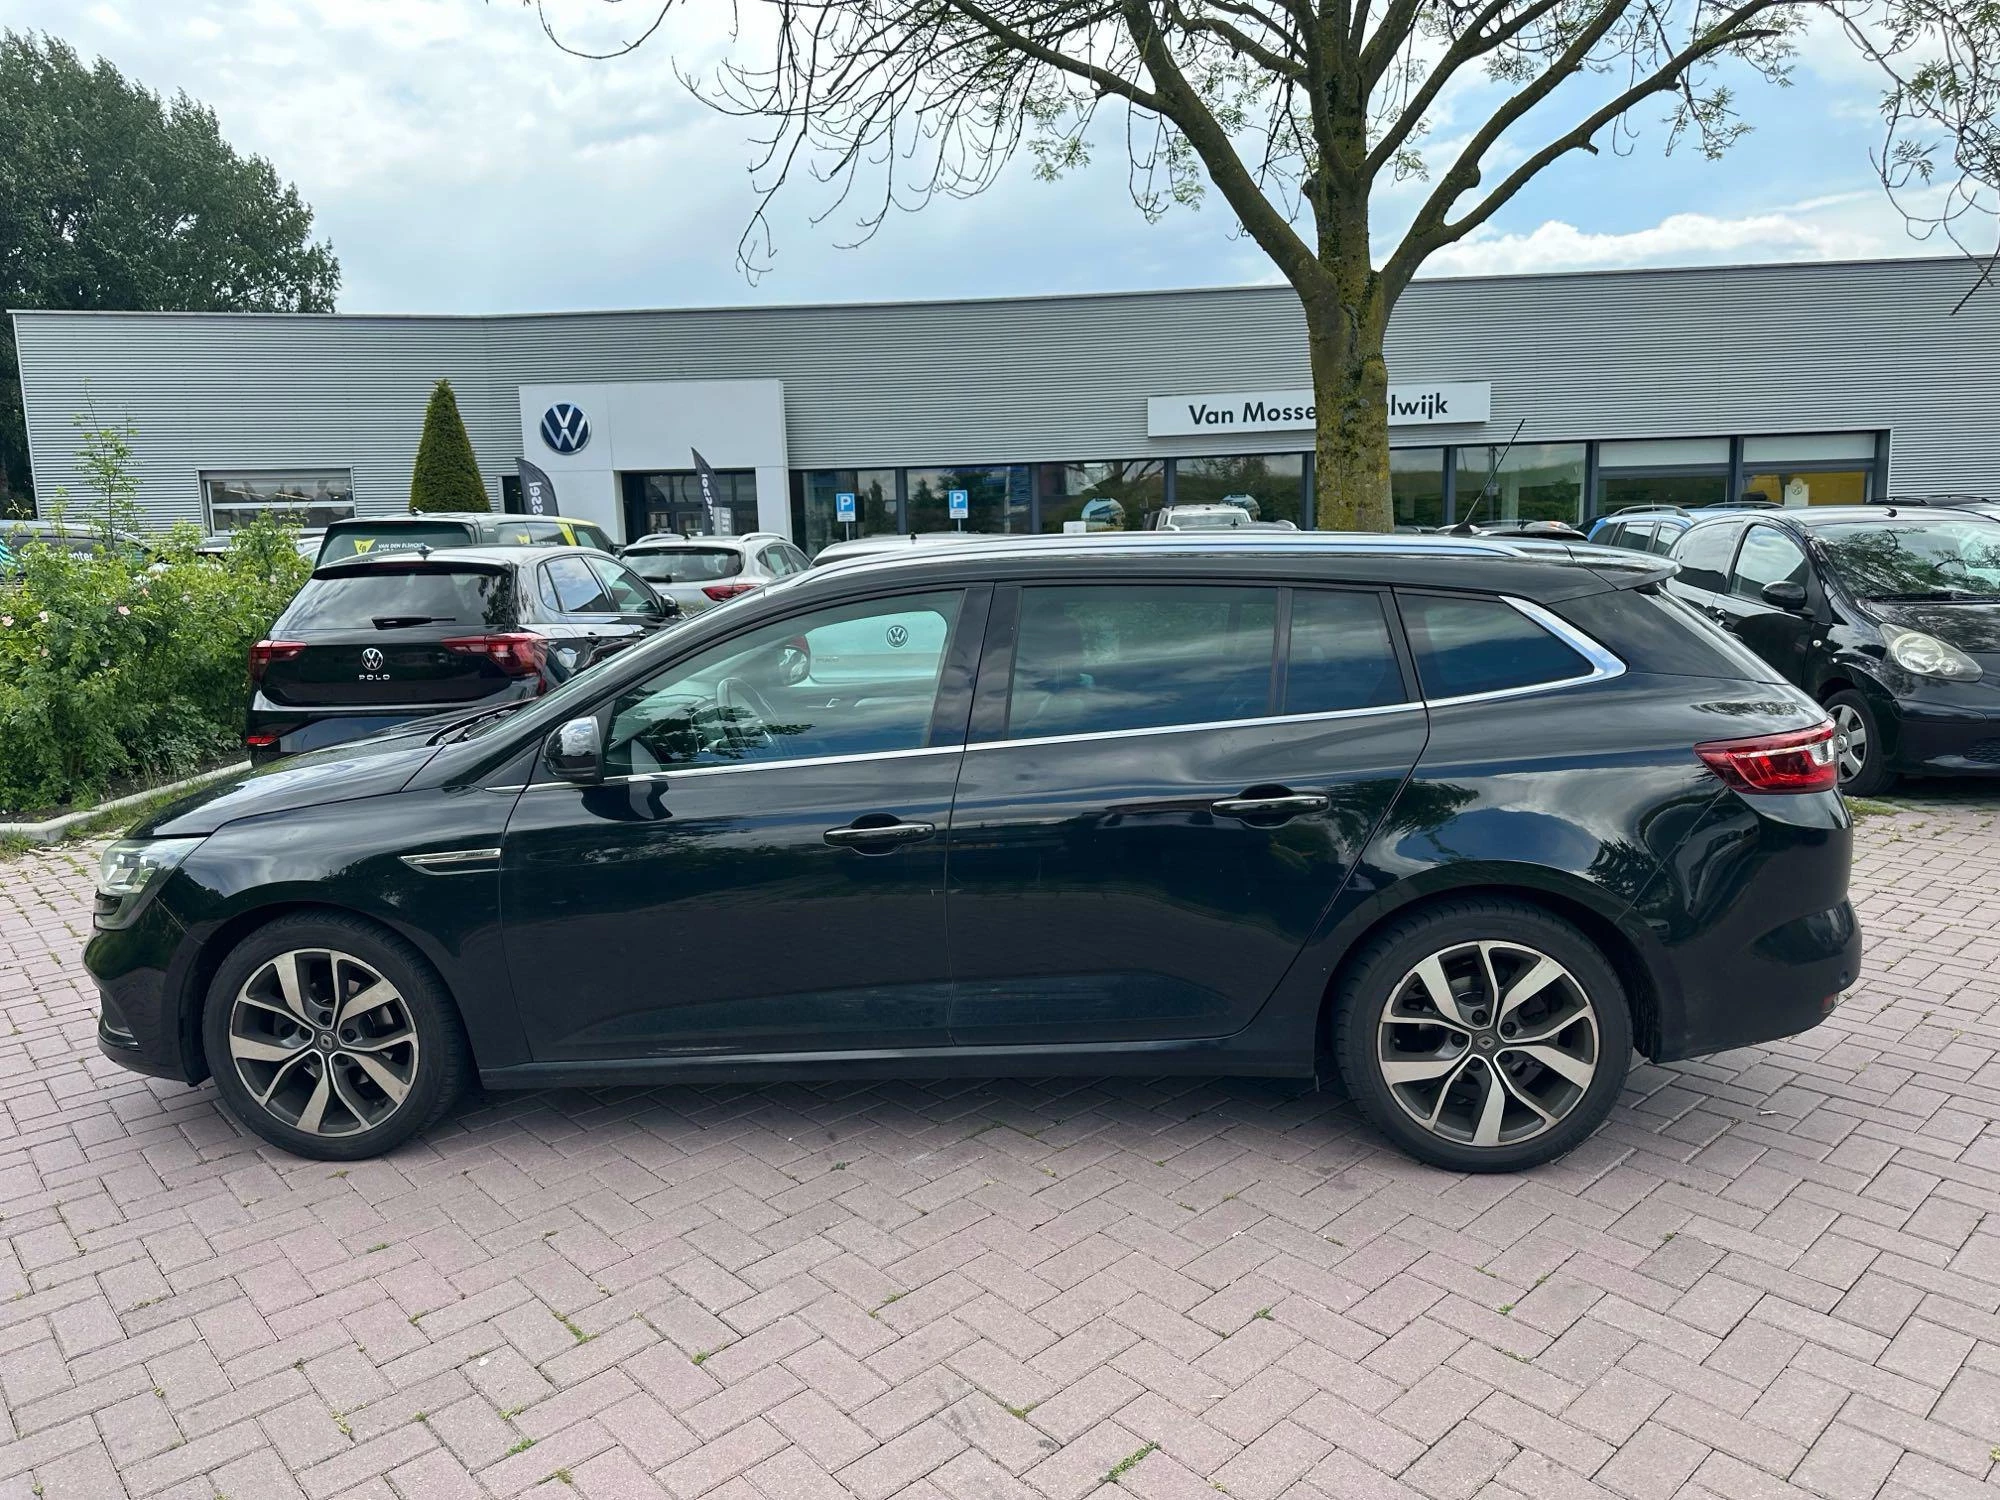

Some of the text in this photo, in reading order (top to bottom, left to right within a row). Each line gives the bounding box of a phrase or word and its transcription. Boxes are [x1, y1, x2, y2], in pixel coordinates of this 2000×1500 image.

[1188, 392, 1448, 425] Van Mosse lwijk
[840, 496, 851, 511] P
[953, 492, 964, 508] P
